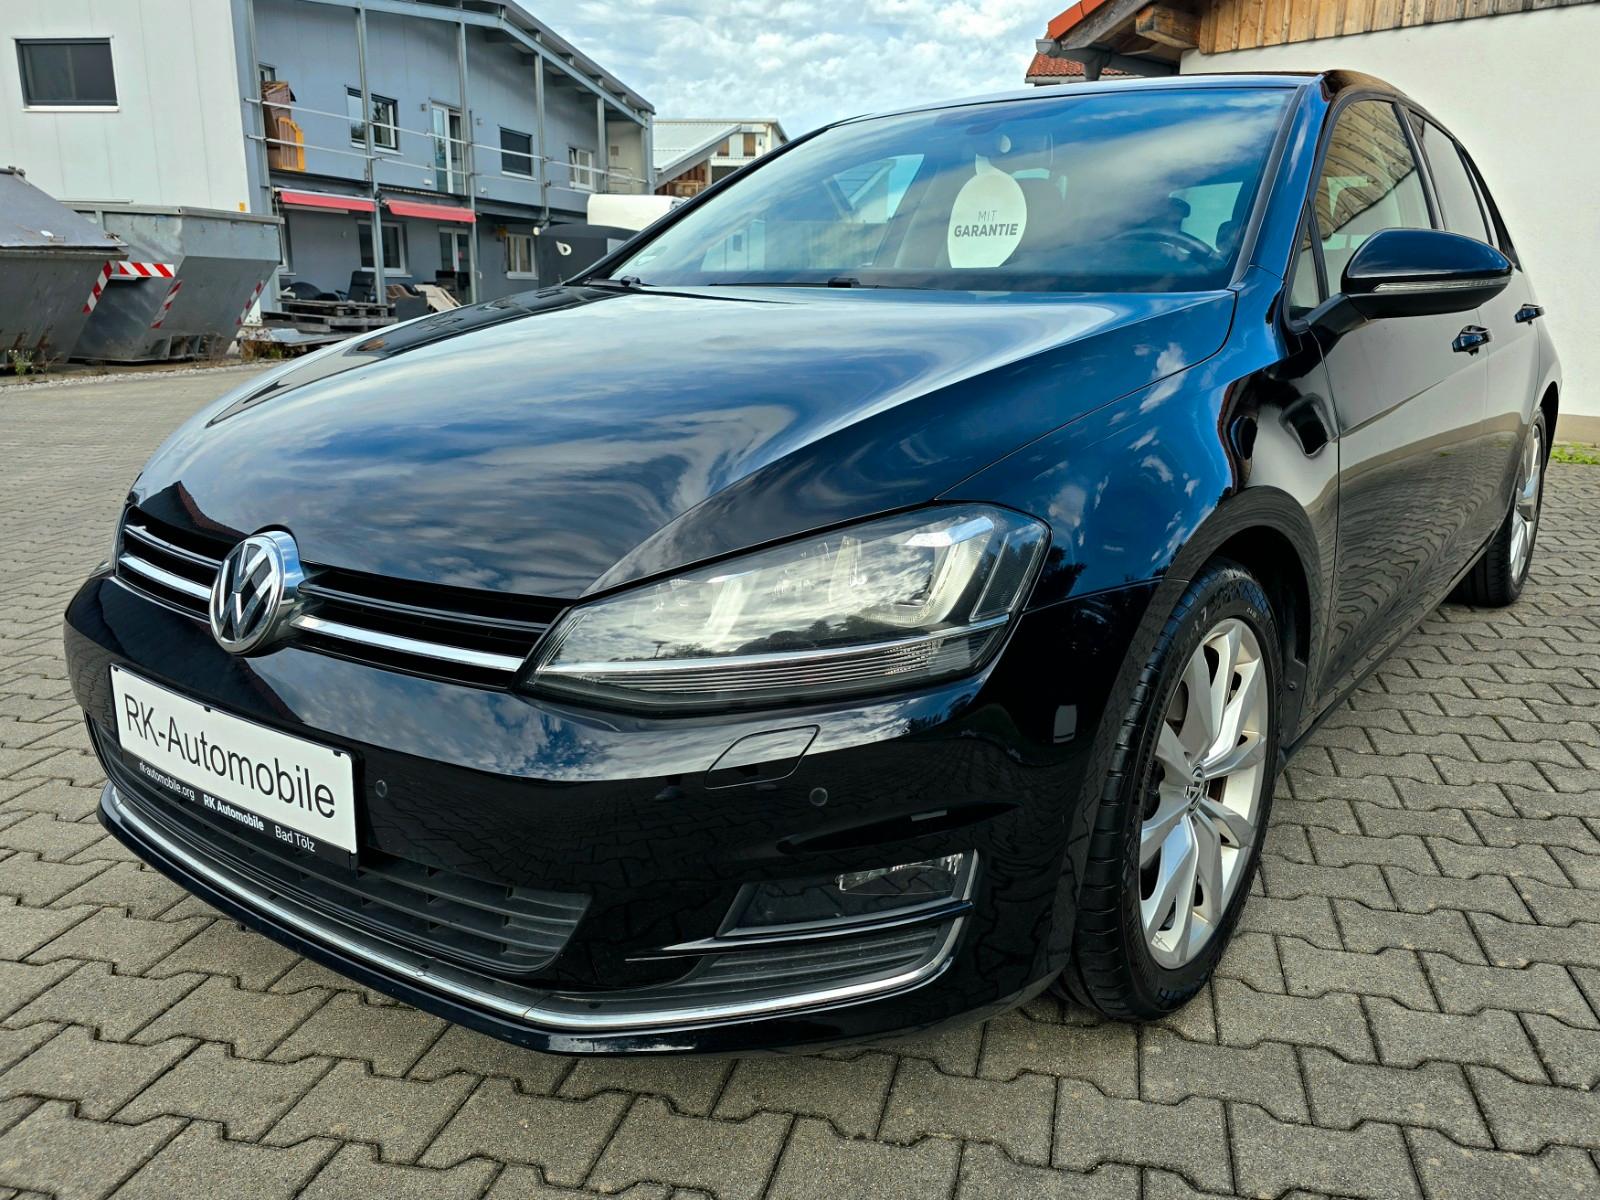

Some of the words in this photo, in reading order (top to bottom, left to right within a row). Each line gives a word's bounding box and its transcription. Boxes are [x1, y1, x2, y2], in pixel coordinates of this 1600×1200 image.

[954, 223, 1018, 237] GARANTIE
[978, 210, 998, 222] MIT
[213, 537, 281, 650] VW
[124, 693, 335, 818] RK-Automobile
[139, 762, 195, 801] rk-automobile.org
[203, 794, 216, 810] RK
[217, 801, 265, 831] Automobile
[275, 825, 293, 844] Bad
[295, 832, 316, 852] Tölz
